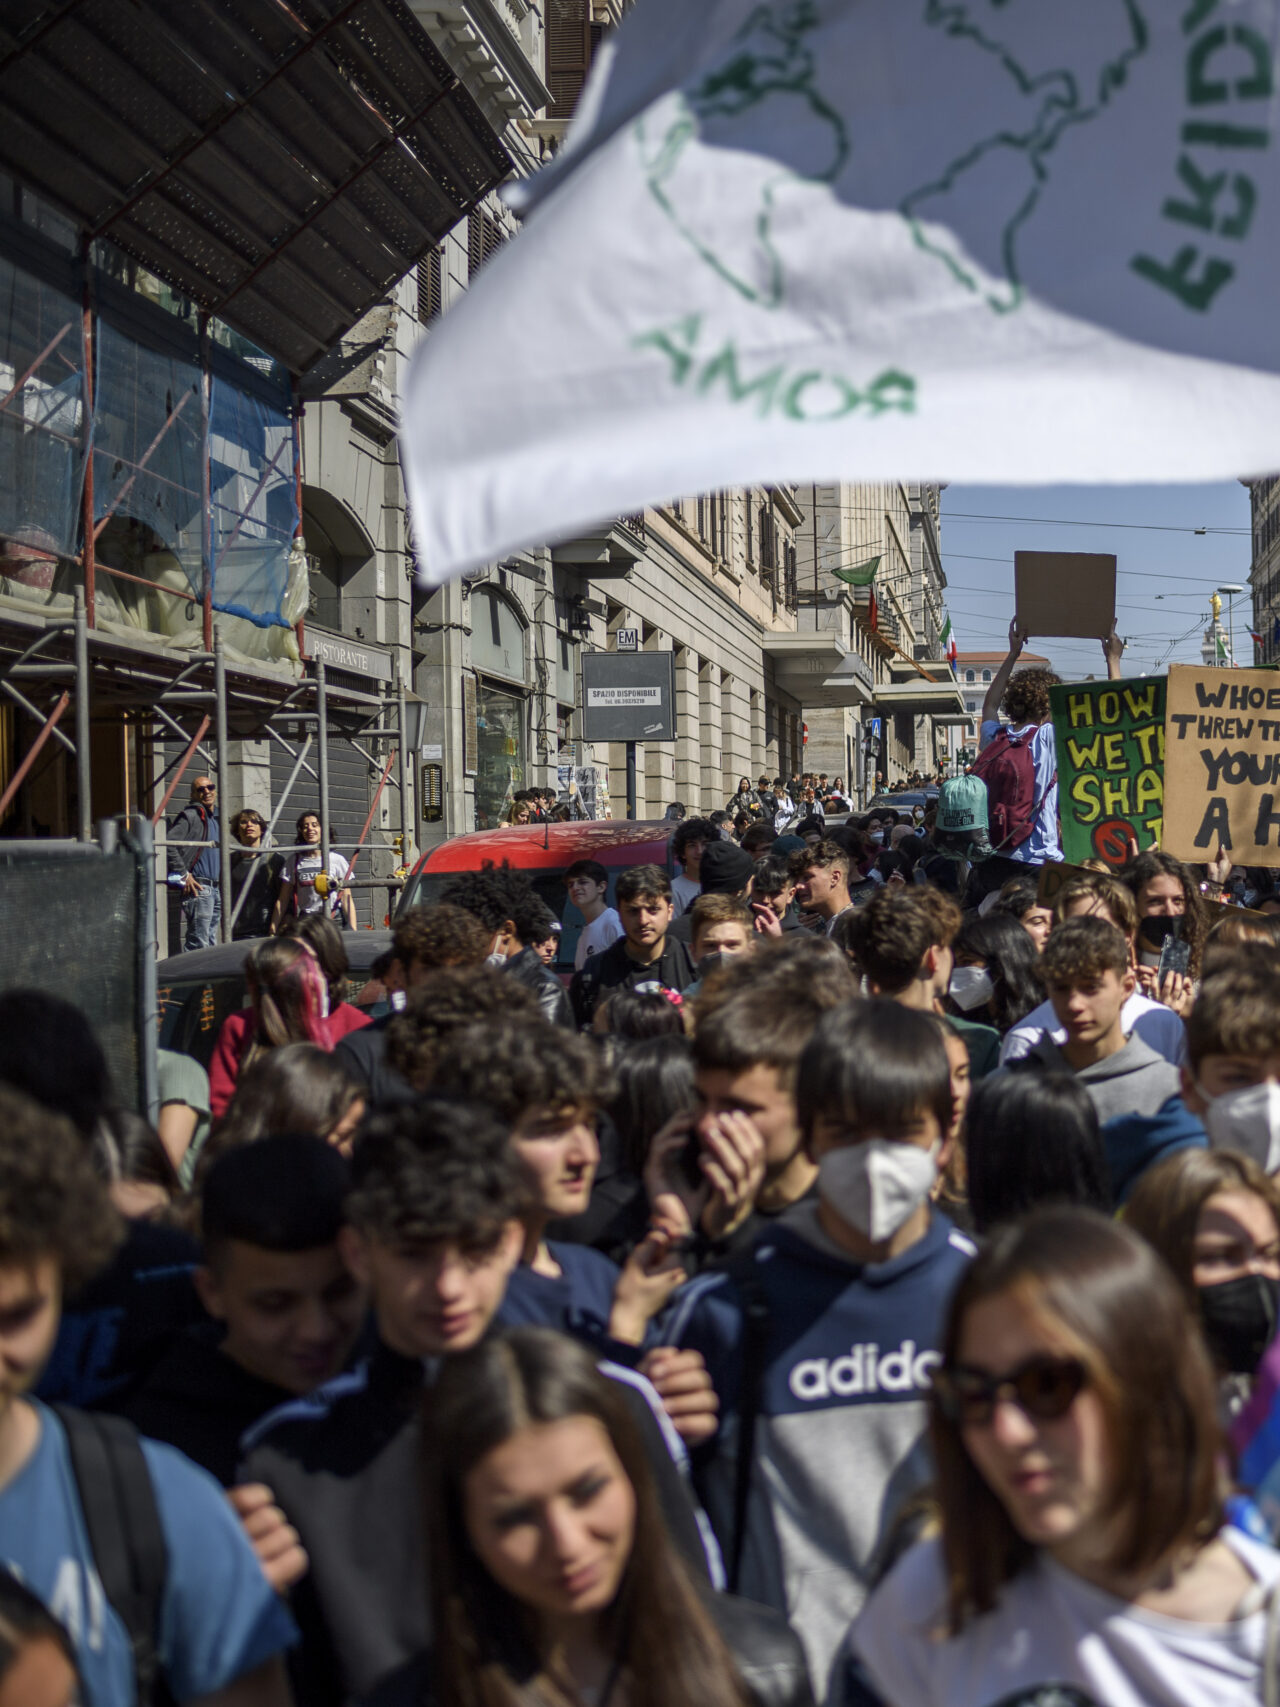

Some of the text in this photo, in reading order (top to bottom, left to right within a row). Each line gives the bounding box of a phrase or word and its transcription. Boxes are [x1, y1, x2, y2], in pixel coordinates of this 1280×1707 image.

[313, 640, 369, 671] RISTORANTE
[1066, 684, 1158, 728] HOW
[1171, 713, 1254, 740] THREW
[1066, 731, 1129, 773] WE
[1193, 797, 1233, 850] A
